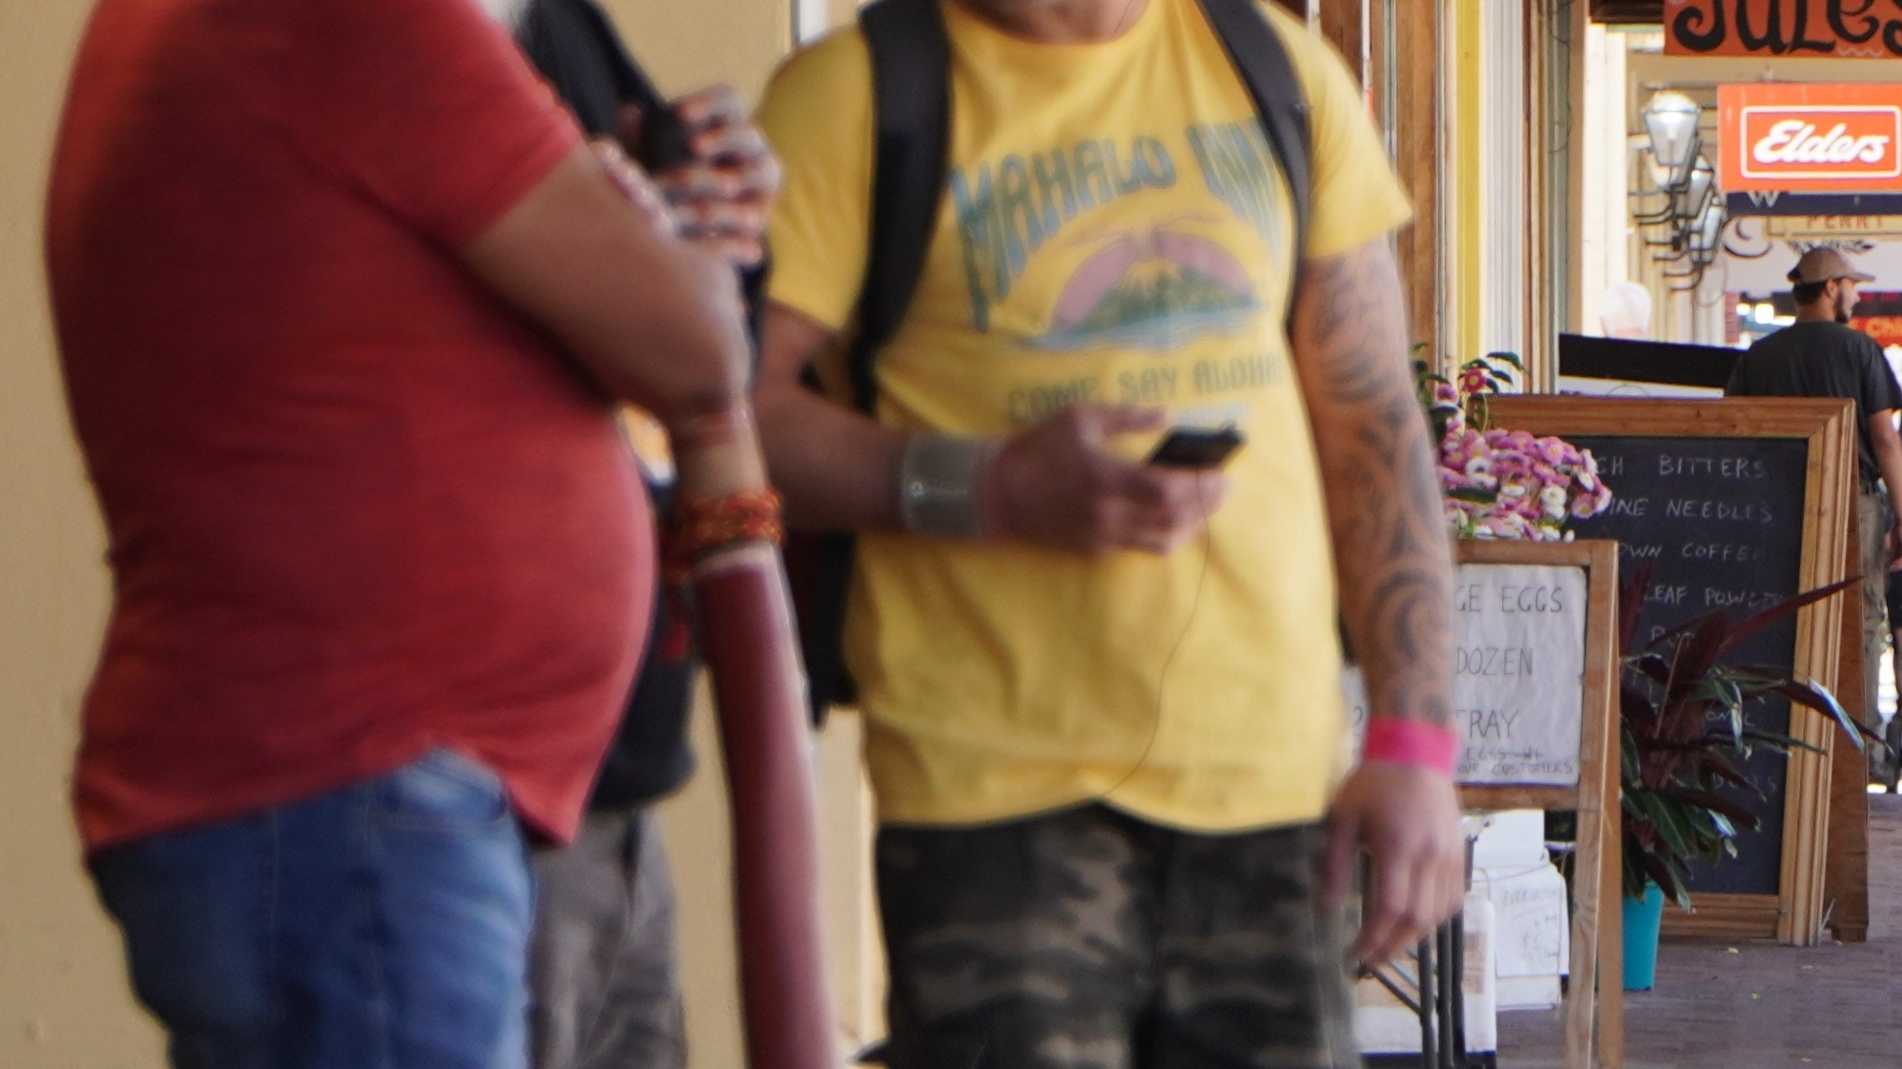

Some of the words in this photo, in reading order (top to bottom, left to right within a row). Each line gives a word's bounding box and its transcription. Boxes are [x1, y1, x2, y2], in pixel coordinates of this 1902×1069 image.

[1753, 119, 1890, 164] Elders
[951, 135, 1177, 334] MAHALO
[1658, 454, 1767, 479] BITTERS
[1666, 498, 1774, 524] NEEDLES
[1501, 585, 1564, 614] EGGS
[1456, 646, 1535, 677] DOZEN
